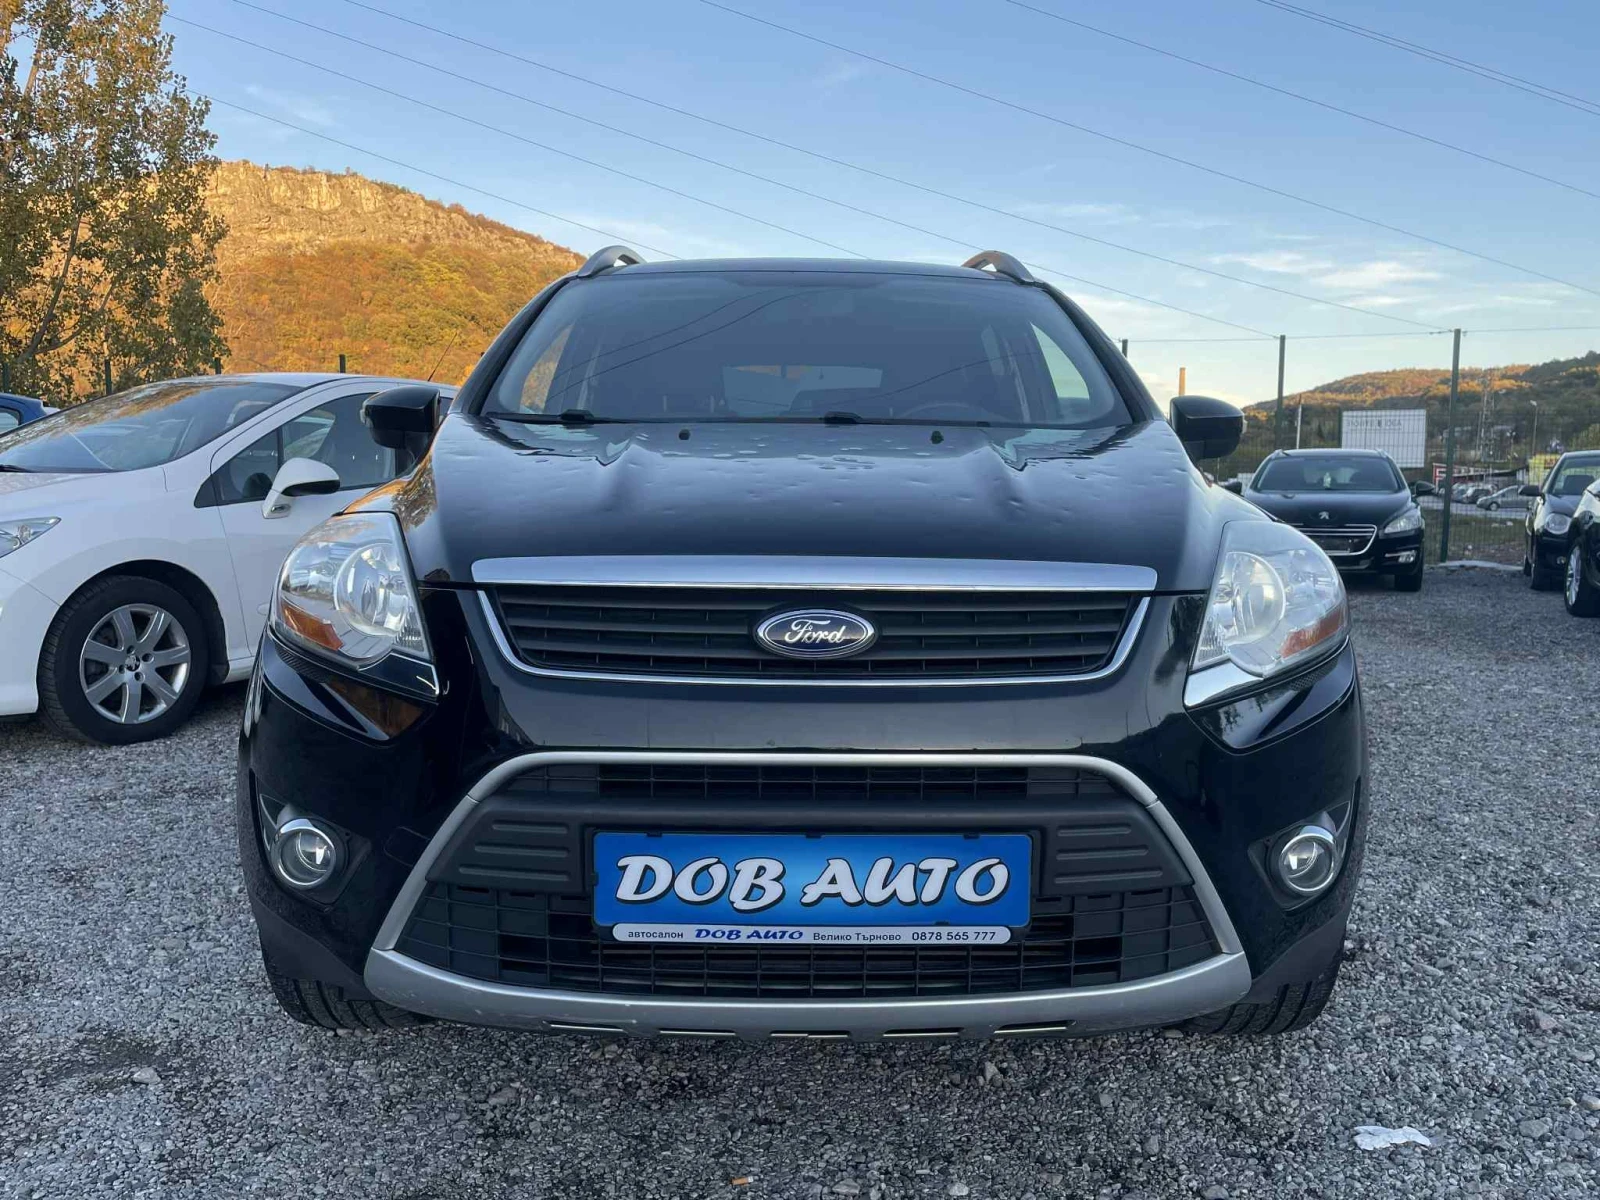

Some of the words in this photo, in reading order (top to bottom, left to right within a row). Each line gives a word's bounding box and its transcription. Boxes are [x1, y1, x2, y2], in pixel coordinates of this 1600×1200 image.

[785, 619, 846, 643] Ford
[616, 855, 785, 912] DOB
[801, 857, 1010, 906] AUTO
[628, 930, 683, 939] автосалон
[694, 928, 741, 941] DOB
[746, 930, 803, 940] AUTO
[813, 932, 852, 941] Велико
[855, 932, 901, 943] Търново
[912, 931, 942, 941] 0878
[946, 931, 969, 941] 565
[973, 931, 996, 941] 777
